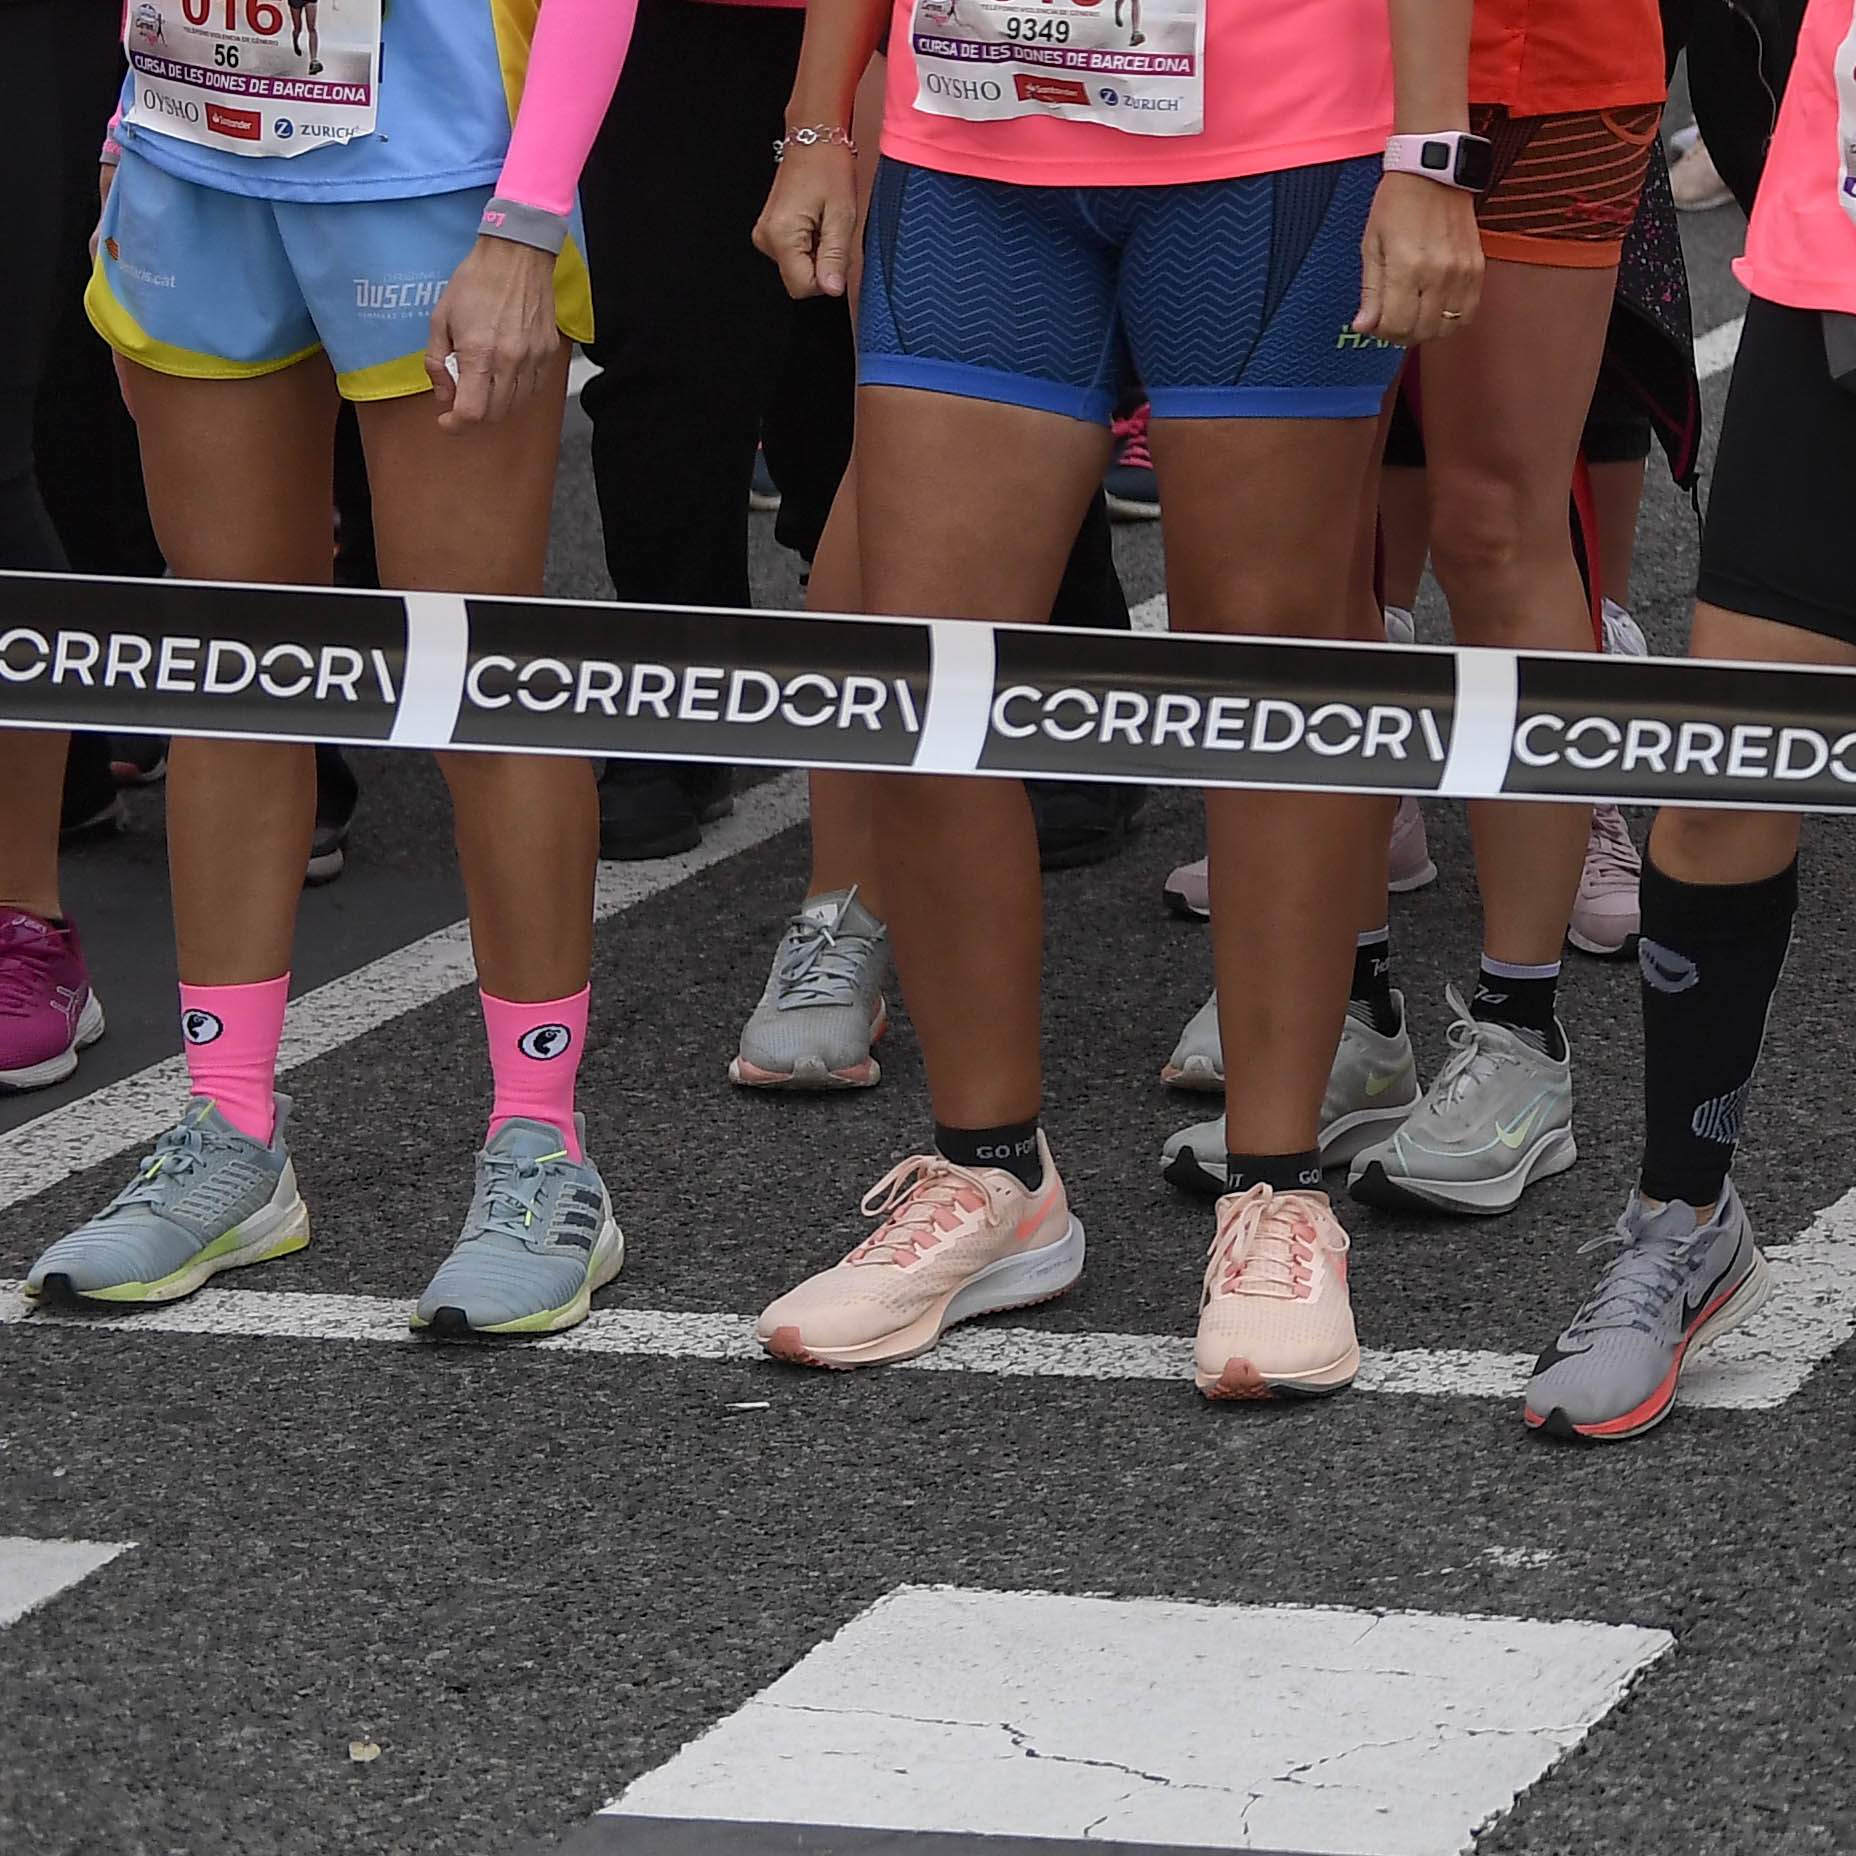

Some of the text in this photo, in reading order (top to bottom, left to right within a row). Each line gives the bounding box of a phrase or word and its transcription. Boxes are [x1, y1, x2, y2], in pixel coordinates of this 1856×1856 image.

[1006, 17, 1070, 44] 9349
[214, 44, 239, 68] 56
[918, 38, 1190, 73] CURSA DE LES DONES DE BARCELONA
[134, 55, 367, 103] CURSA DE LES DONES DE BARCELONA
[927, 73, 1179, 112] OYSHO ZURICH
[143, 89, 199, 124] OYSHO
[976, 1144, 1010, 1160] GO
[1299, 1168, 1320, 1185] GO
